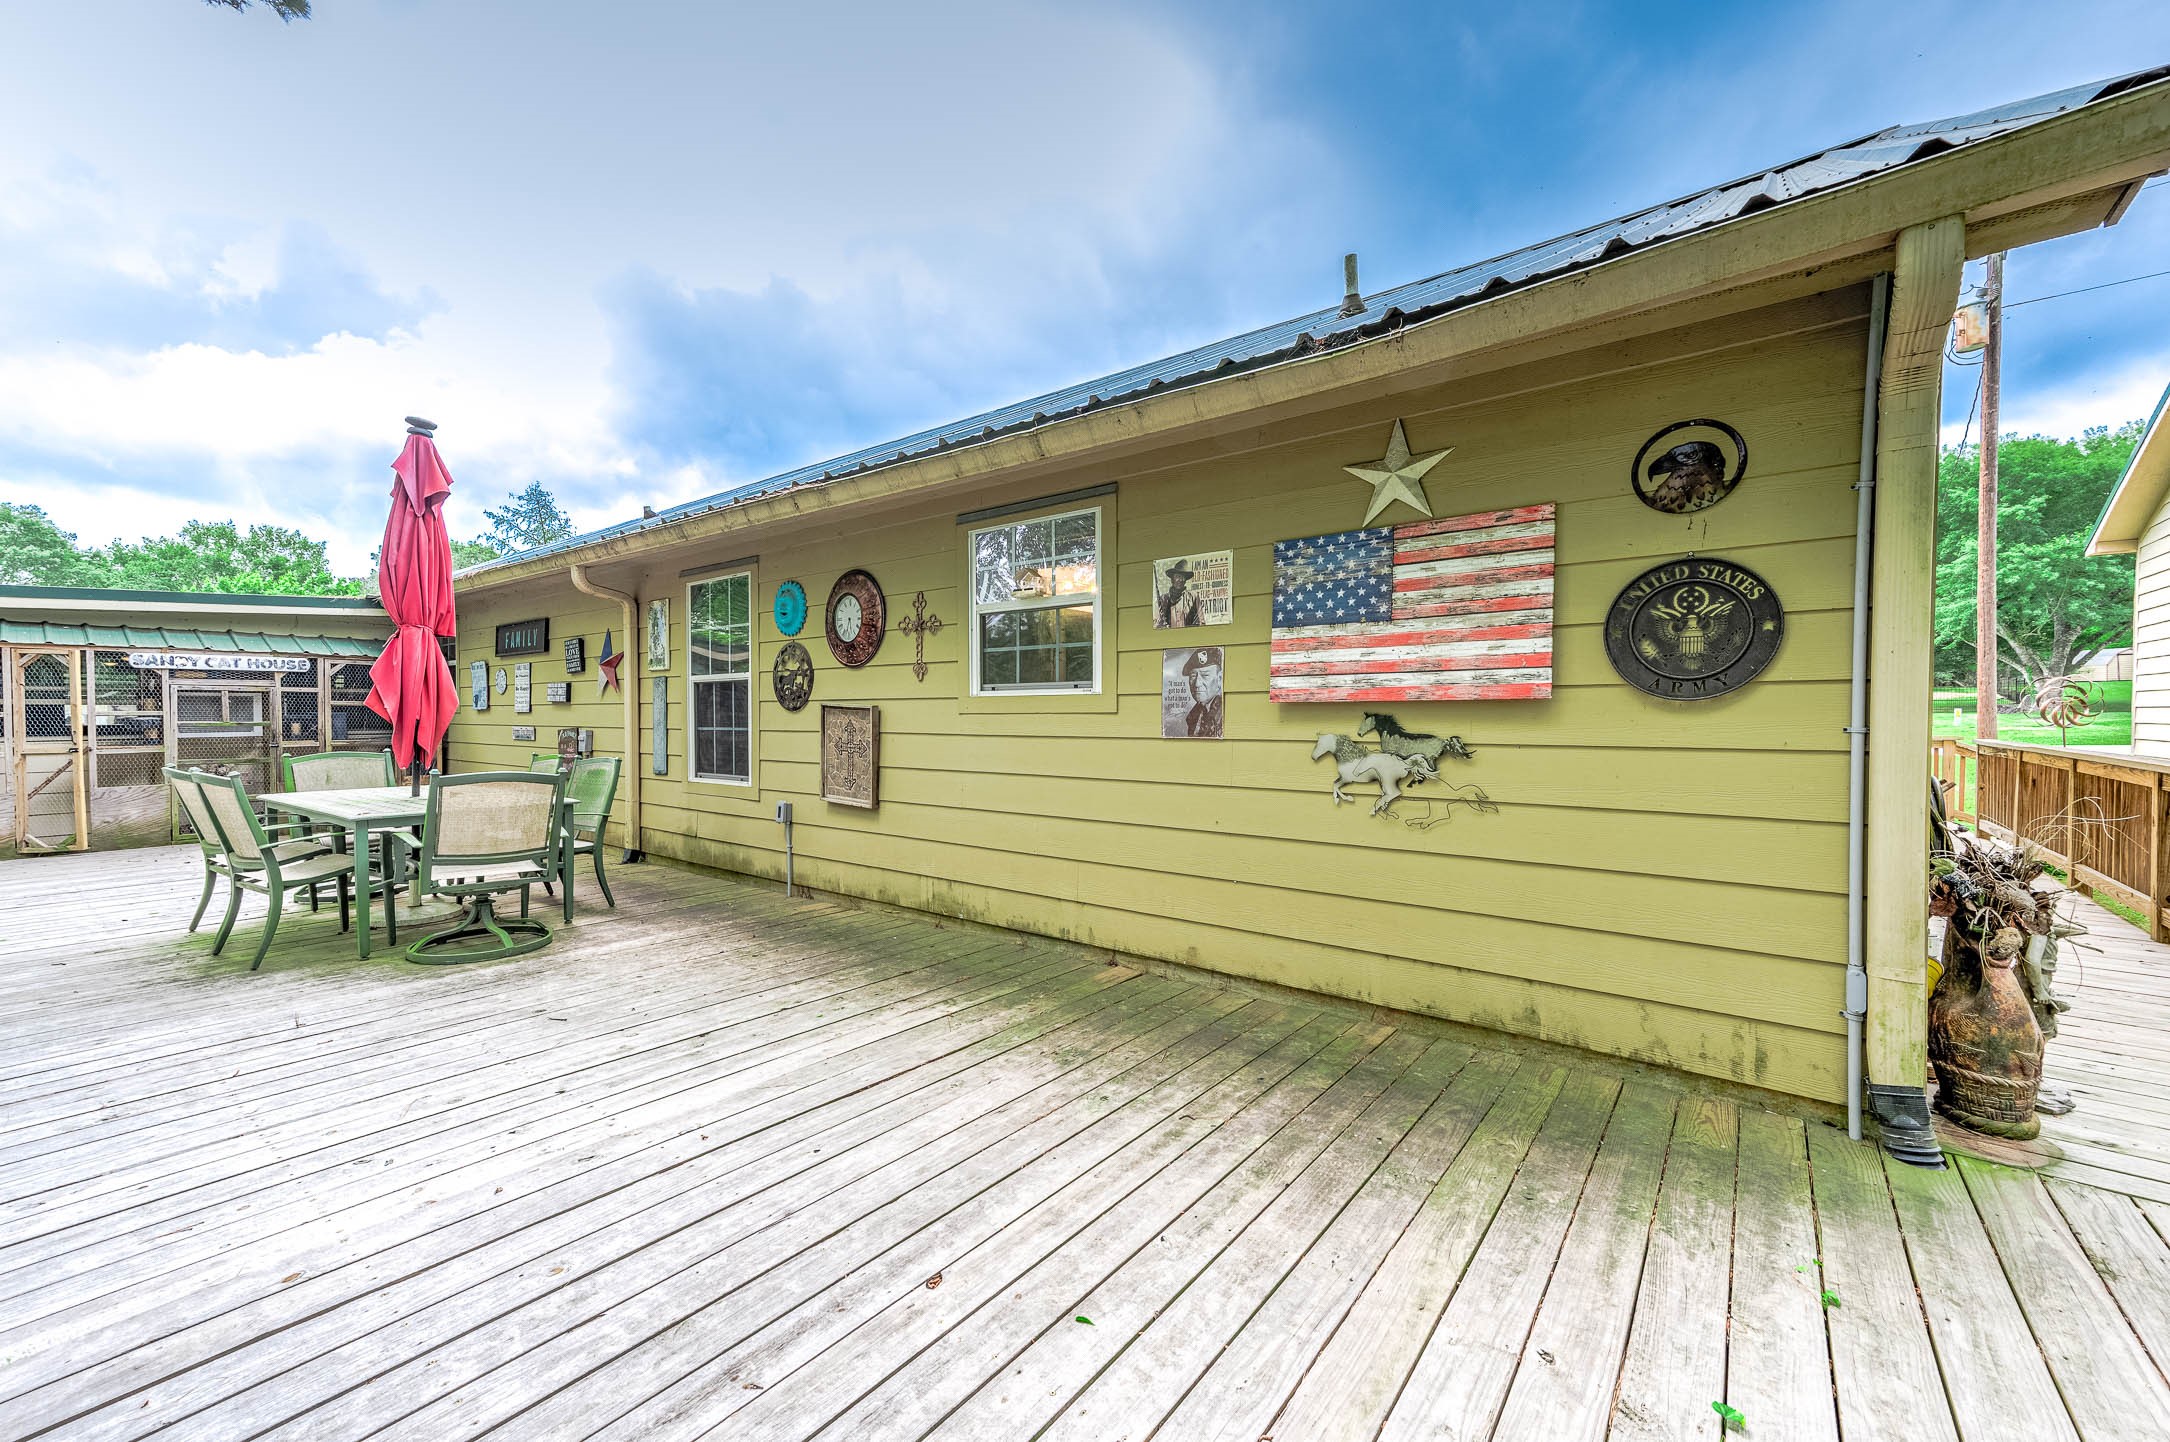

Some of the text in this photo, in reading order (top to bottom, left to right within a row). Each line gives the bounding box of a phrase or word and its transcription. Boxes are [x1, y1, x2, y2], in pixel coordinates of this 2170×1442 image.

[1618, 564, 1765, 609] UNITED STATES
[1200, 598, 1229, 614] PATRIOT
[505, 628, 538, 649] FAMILY
[565, 648, 580, 657] LOVE
[205, 657, 241, 669] CAT
[247, 658, 309, 671] HOUSE
[1649, 673, 1730, 693] ARMY
